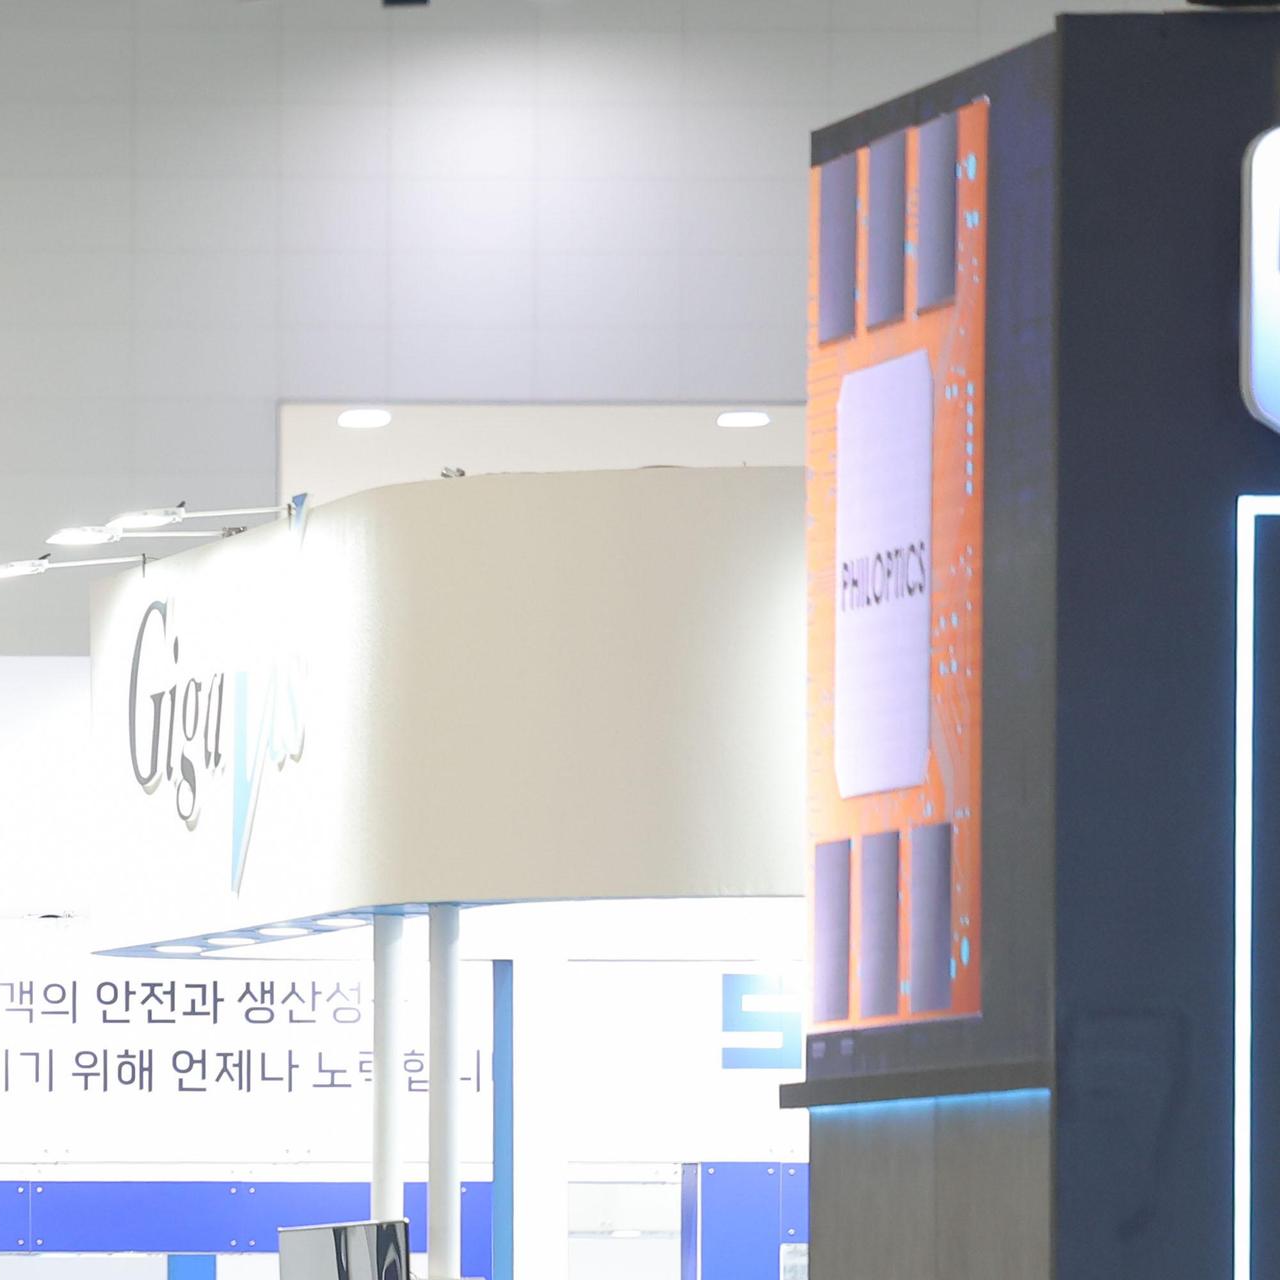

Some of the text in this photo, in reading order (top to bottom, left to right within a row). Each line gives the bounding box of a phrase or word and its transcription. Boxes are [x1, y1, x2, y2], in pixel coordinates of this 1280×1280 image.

[842, 541, 925, 612] PHILOPTICS
[95, 980, 224, 1024] 안전과
[71, 1049, 154, 1094] 위해
[171, 1049, 300, 1094] 언제나
